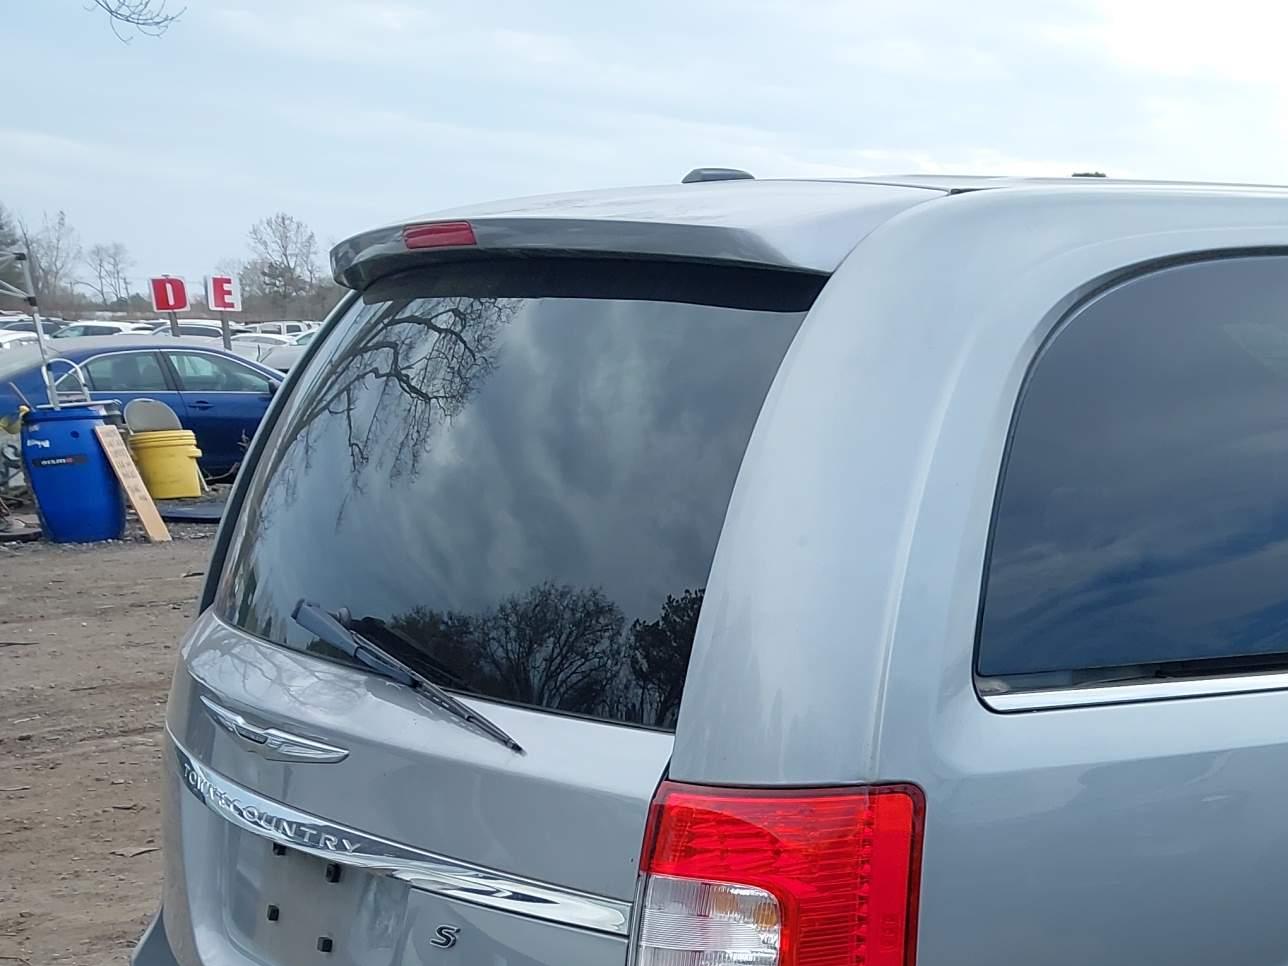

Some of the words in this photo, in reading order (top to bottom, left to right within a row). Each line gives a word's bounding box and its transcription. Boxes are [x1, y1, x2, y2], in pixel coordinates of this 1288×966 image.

[151, 277, 188, 311] D
[212, 276, 235, 309] E
[430, 925, 462, 949] S
